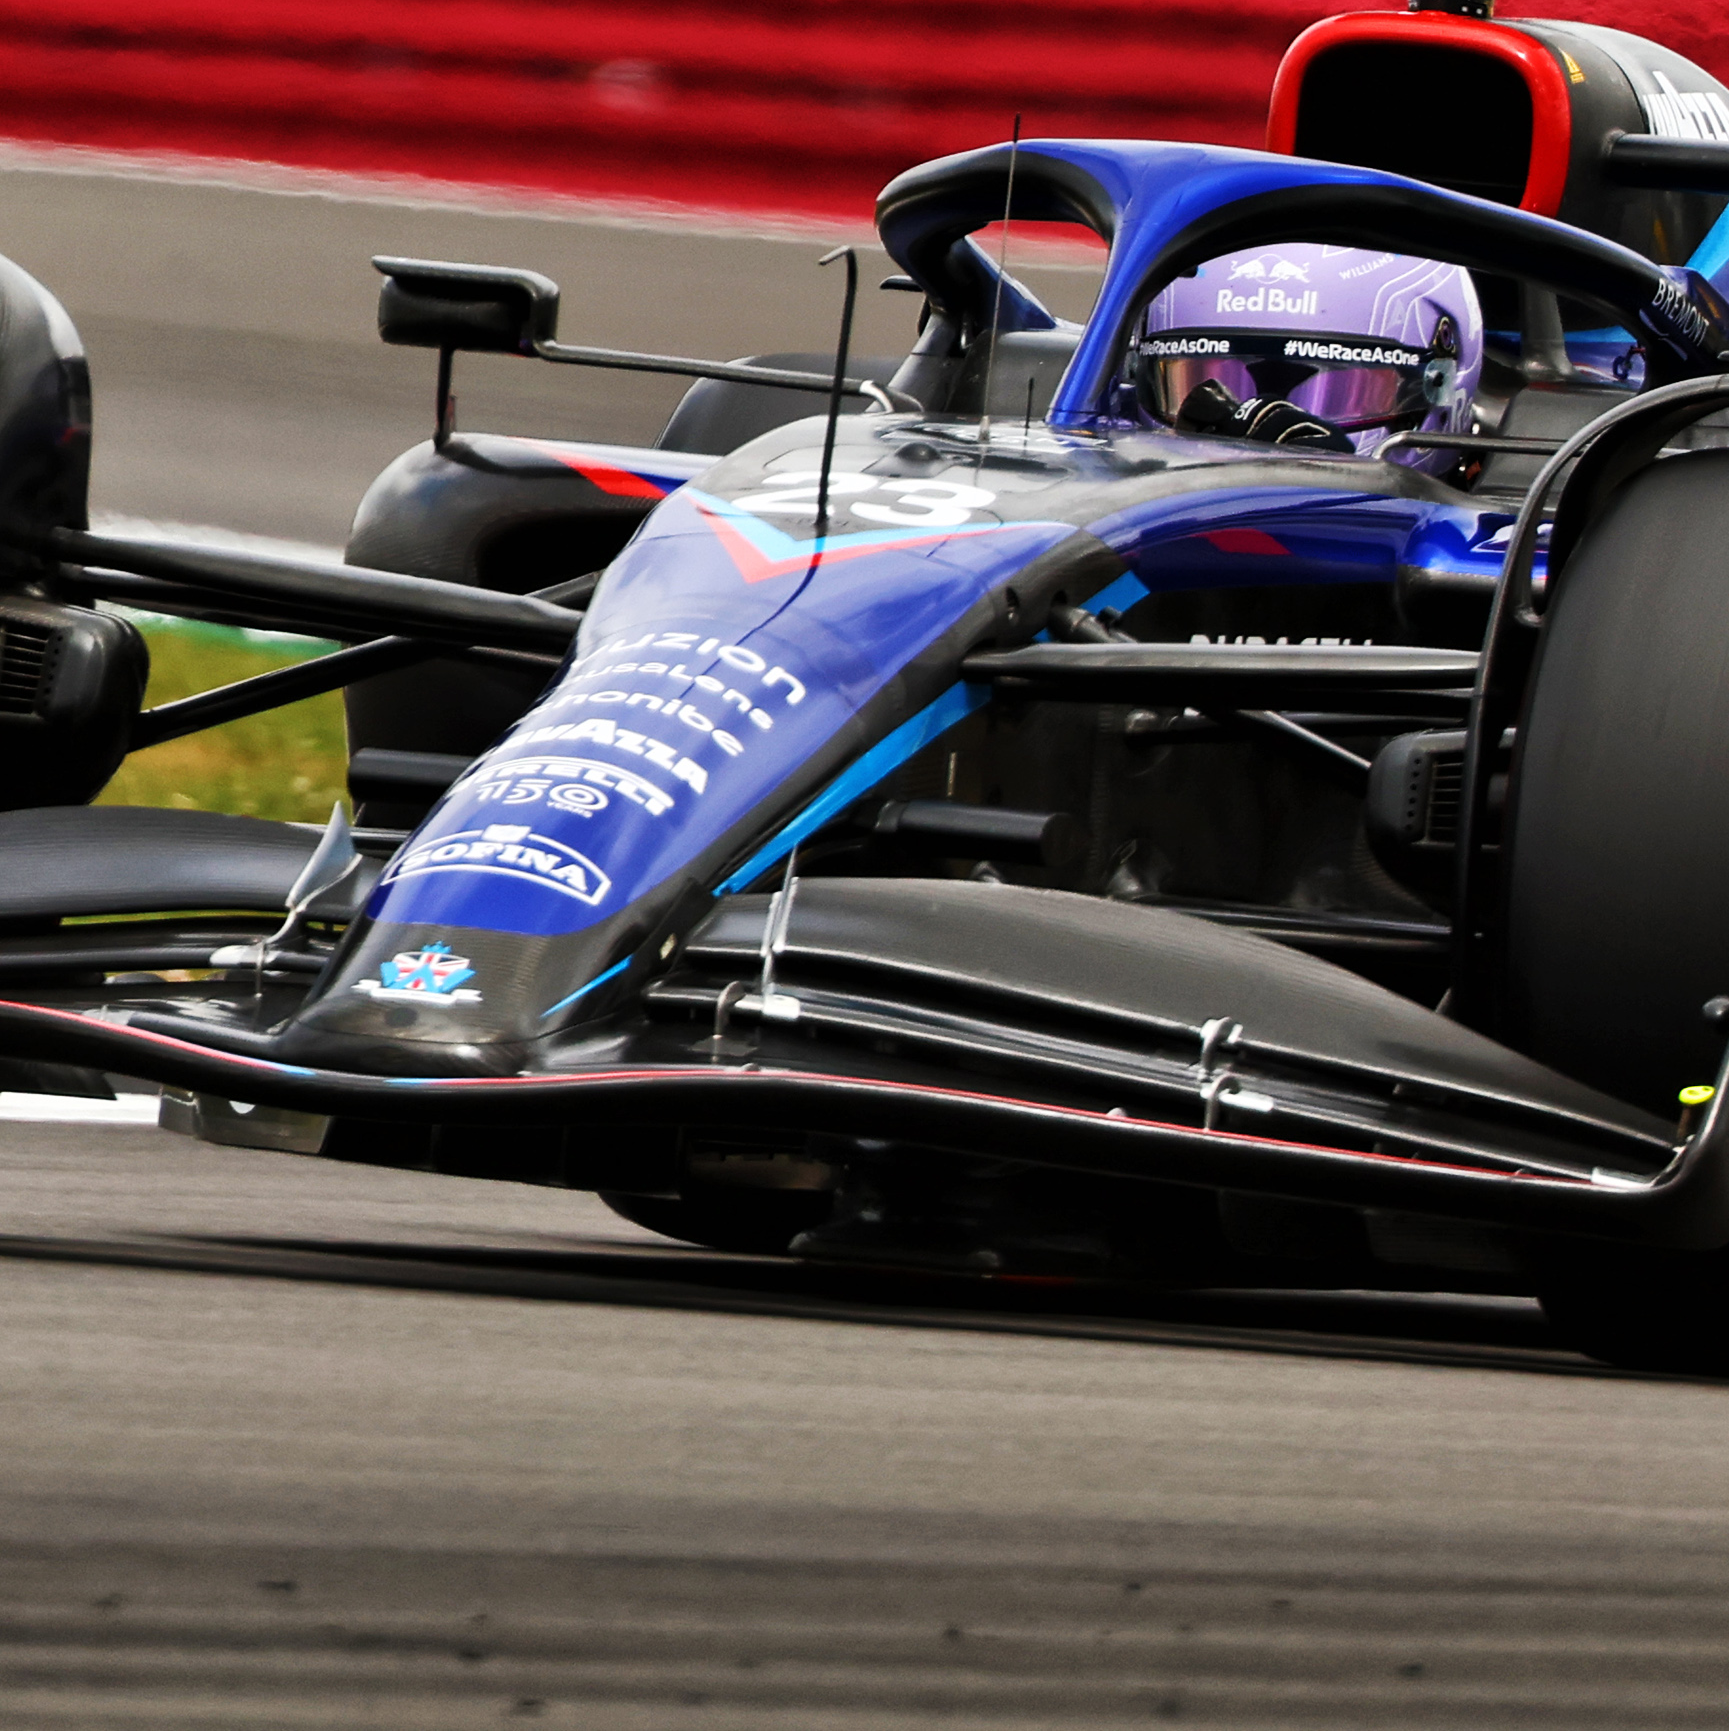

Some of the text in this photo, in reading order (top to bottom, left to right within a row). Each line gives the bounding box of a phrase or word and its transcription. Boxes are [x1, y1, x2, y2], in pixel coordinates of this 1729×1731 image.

[1215, 287, 1318, 315] Red Bull
[1652, 277, 1710, 347] BREMONT
[1284, 340, 1420, 366] #WeRaceAsOne
[731, 470, 997, 528] 23
[398, 841, 589, 893] SOFINA
